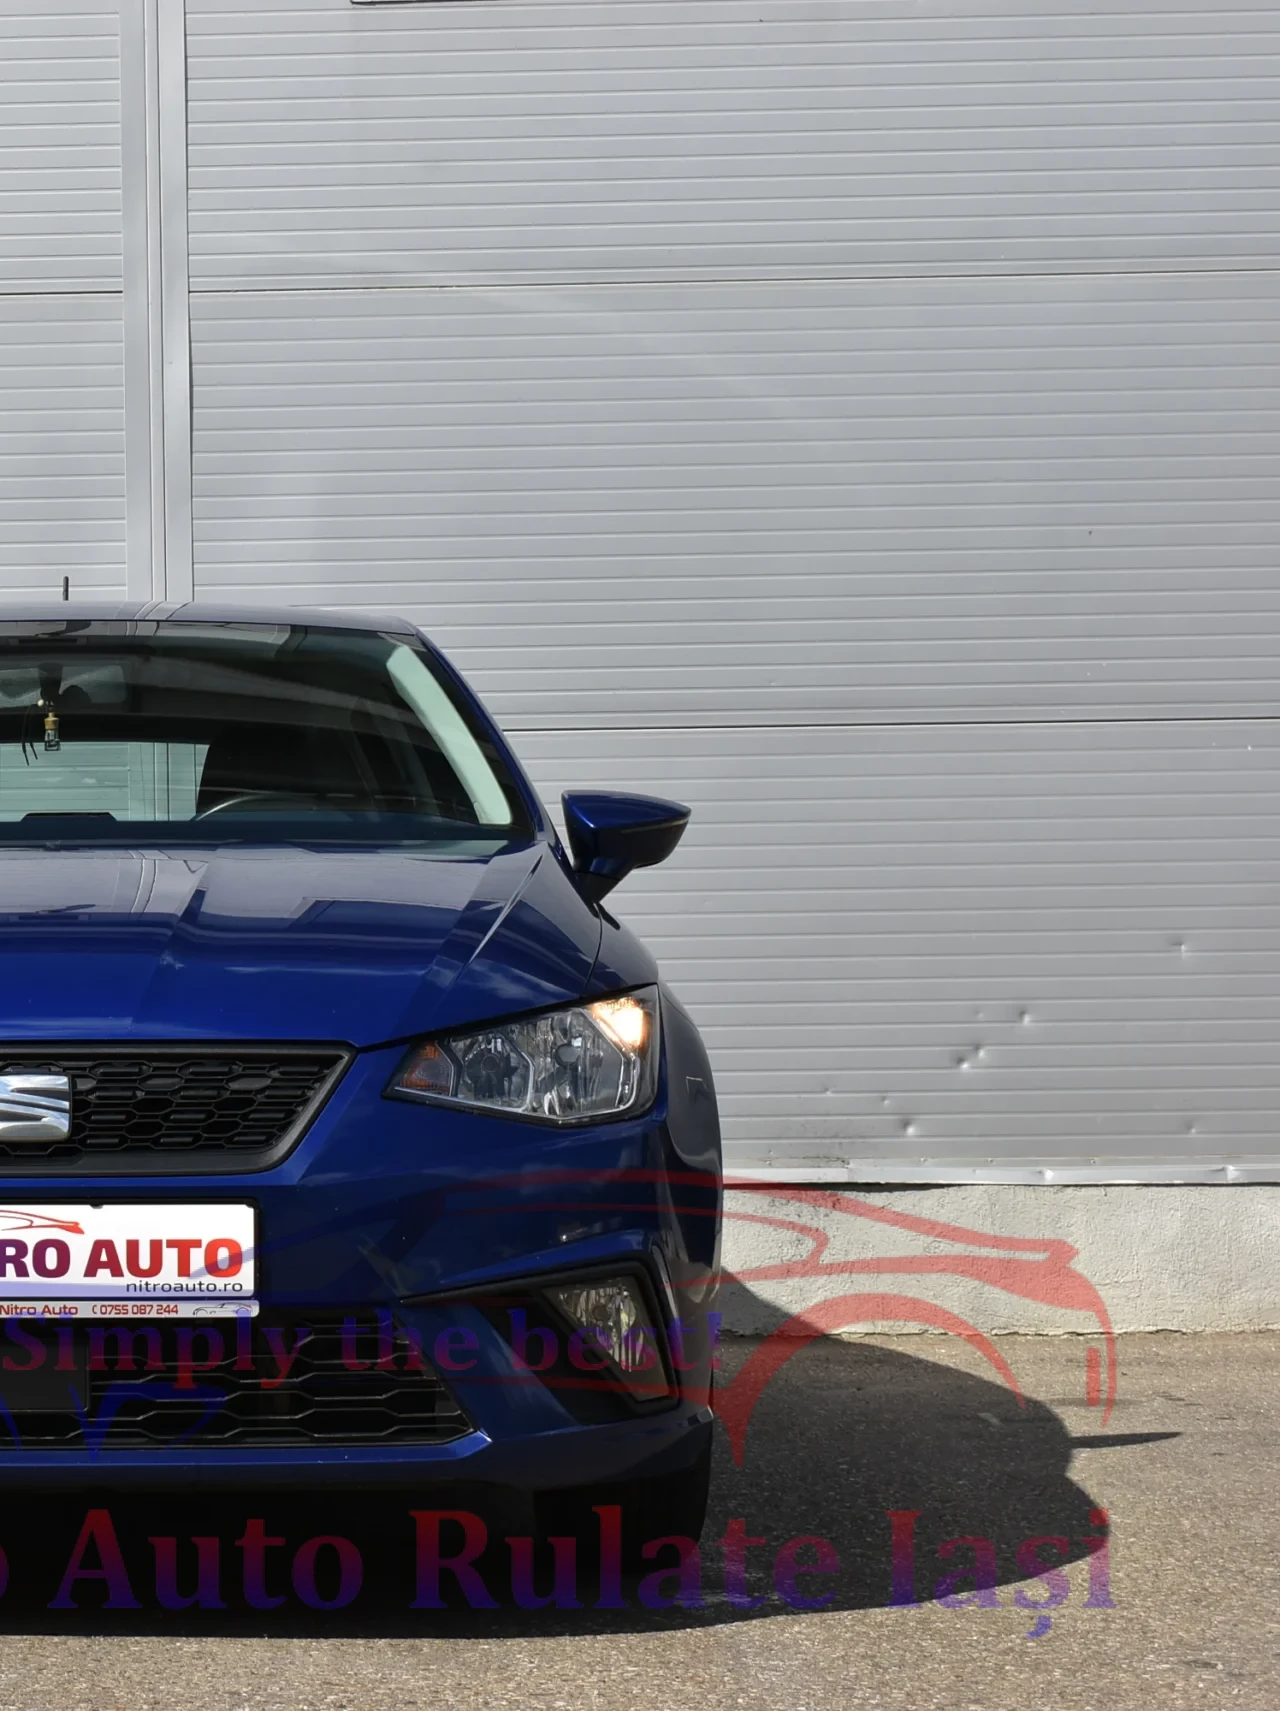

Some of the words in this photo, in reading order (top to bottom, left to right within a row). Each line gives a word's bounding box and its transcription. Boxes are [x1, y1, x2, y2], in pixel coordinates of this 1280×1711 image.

[83, 1237, 244, 1278] AUTO
[125, 1279, 244, 1294] nitroauto.ro
[41, 1303, 79, 1316] Auto
[131, 1303, 154, 1316] 087
[155, 1303, 179, 1316] 244
